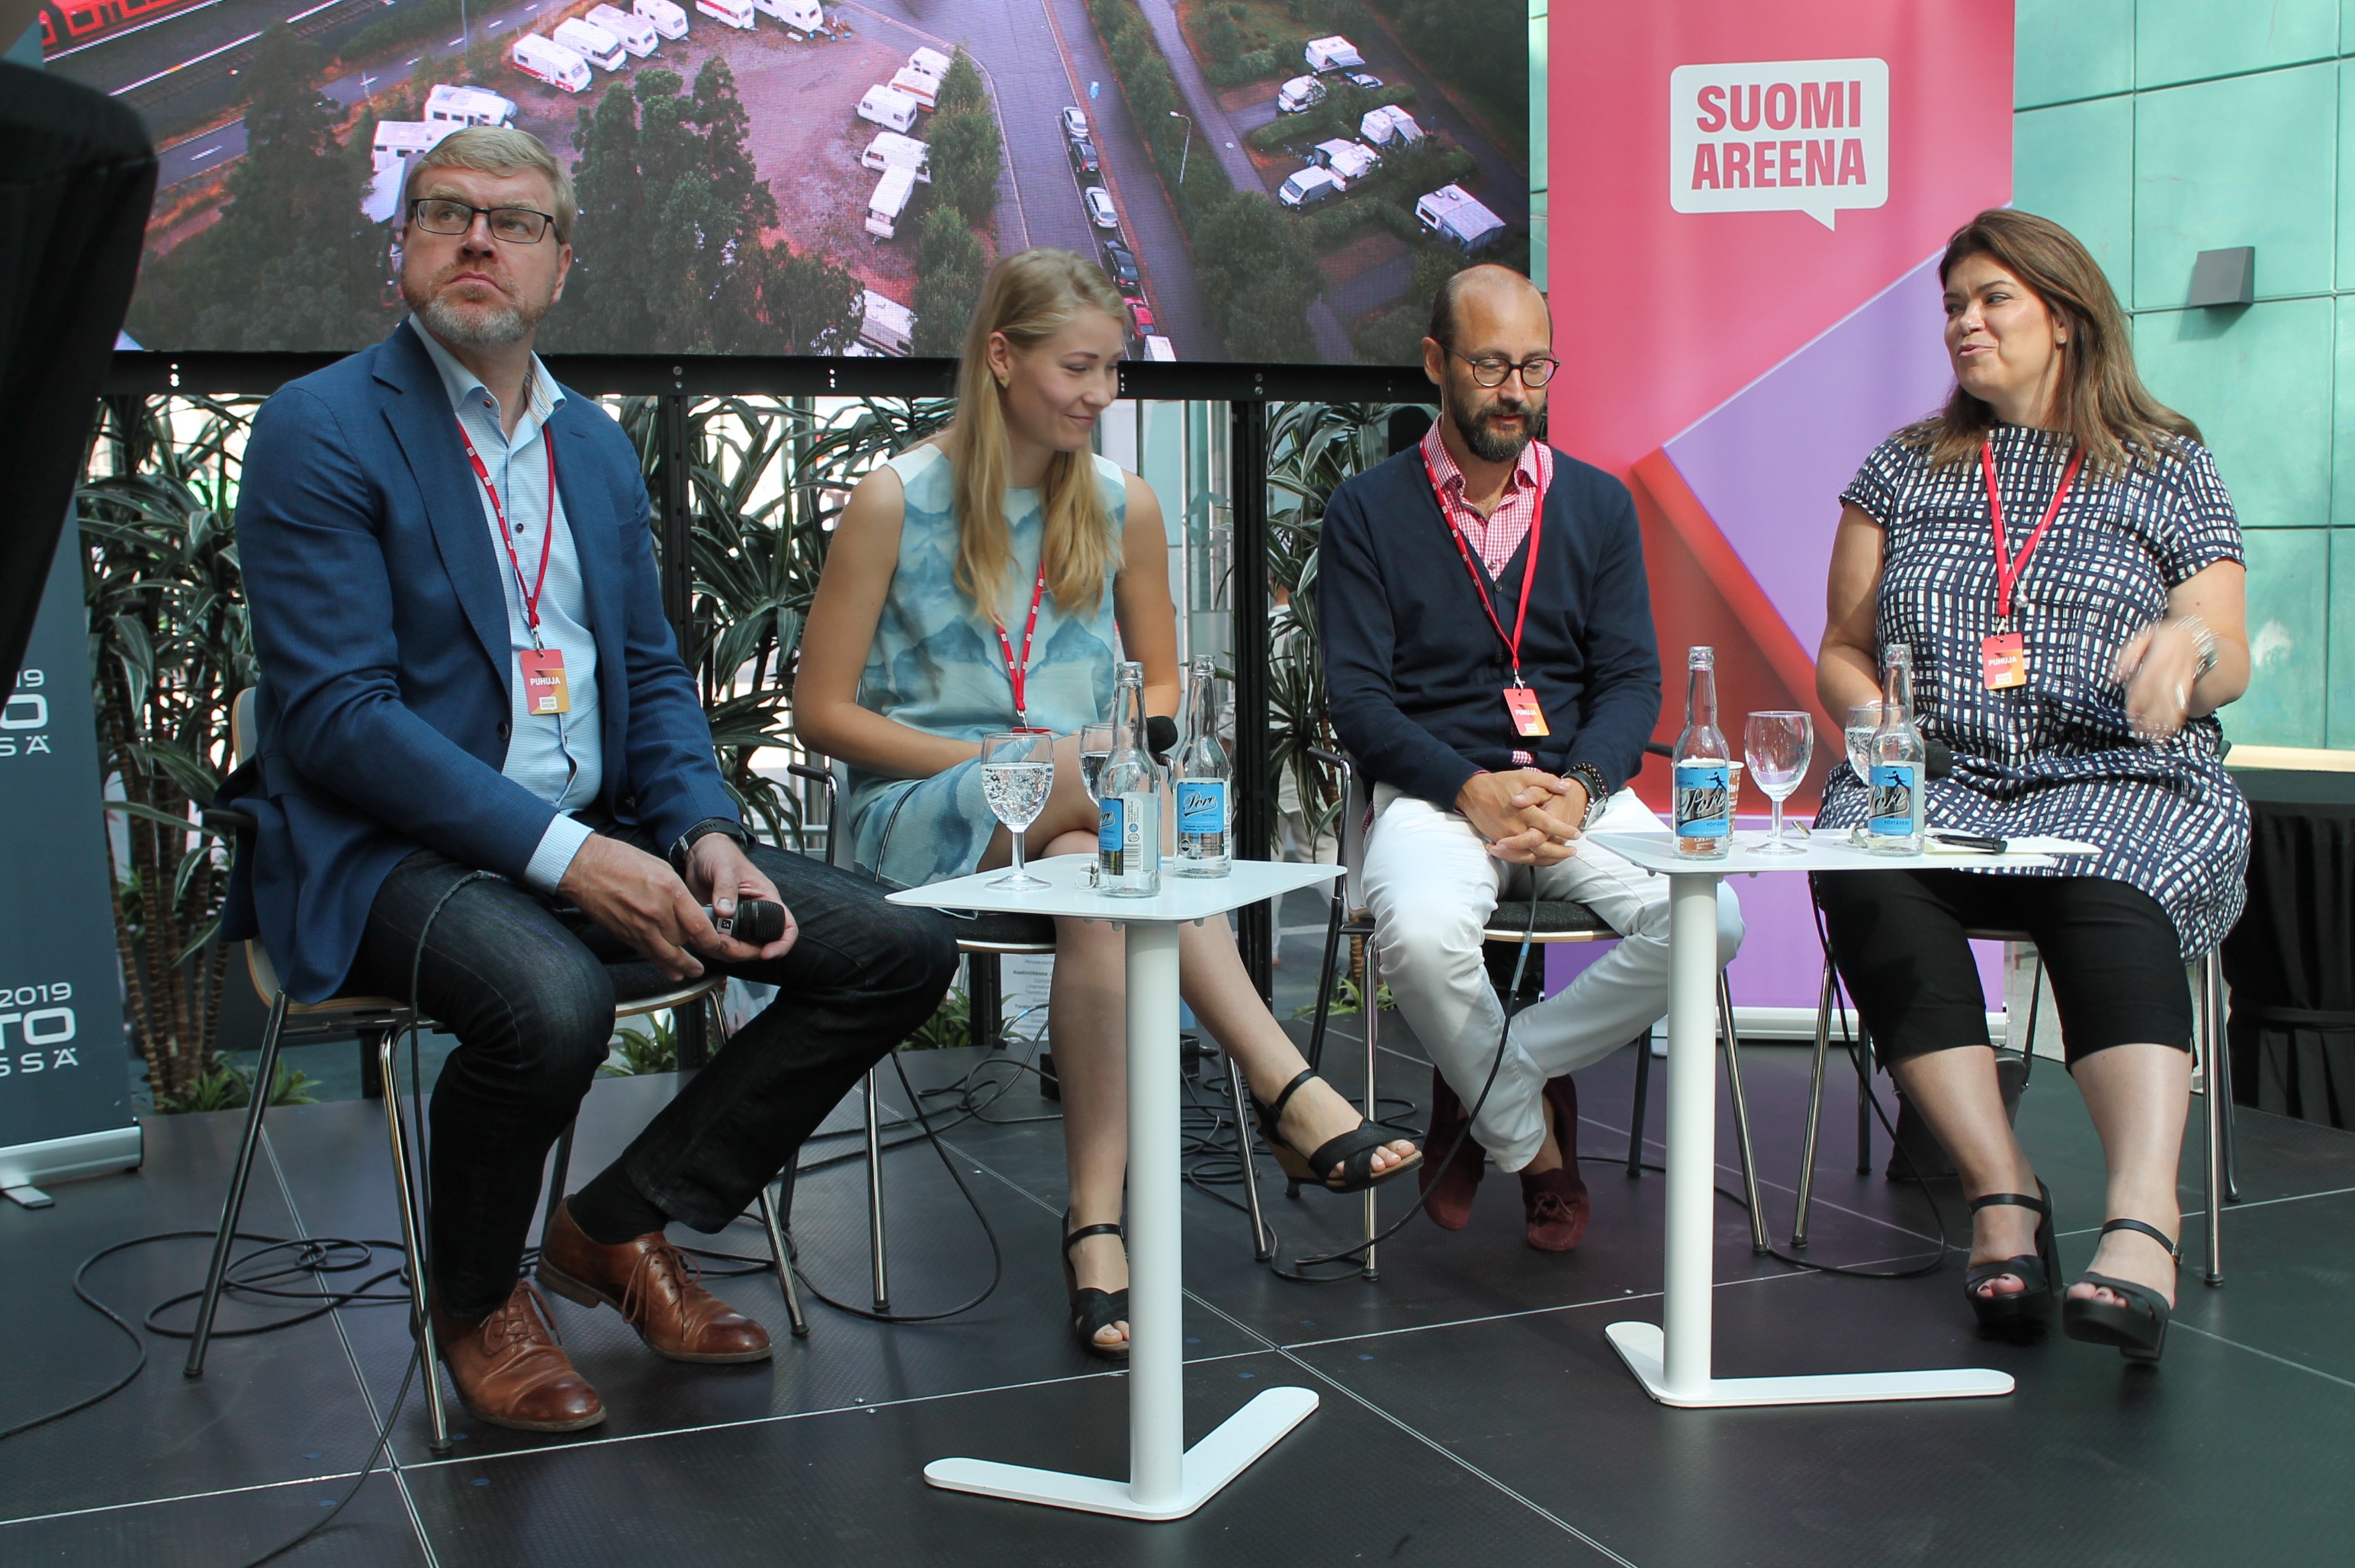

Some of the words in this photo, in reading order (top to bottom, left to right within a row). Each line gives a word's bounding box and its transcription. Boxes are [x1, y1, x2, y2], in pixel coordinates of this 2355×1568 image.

[1696, 81, 1861, 133] SUOMI
[1691, 138, 1867, 190] AREENA
[1987, 656, 2018, 666] PUHUJA
[530, 676, 561, 686] PUHUJA
[0, 982, 72, 1007] 2019
